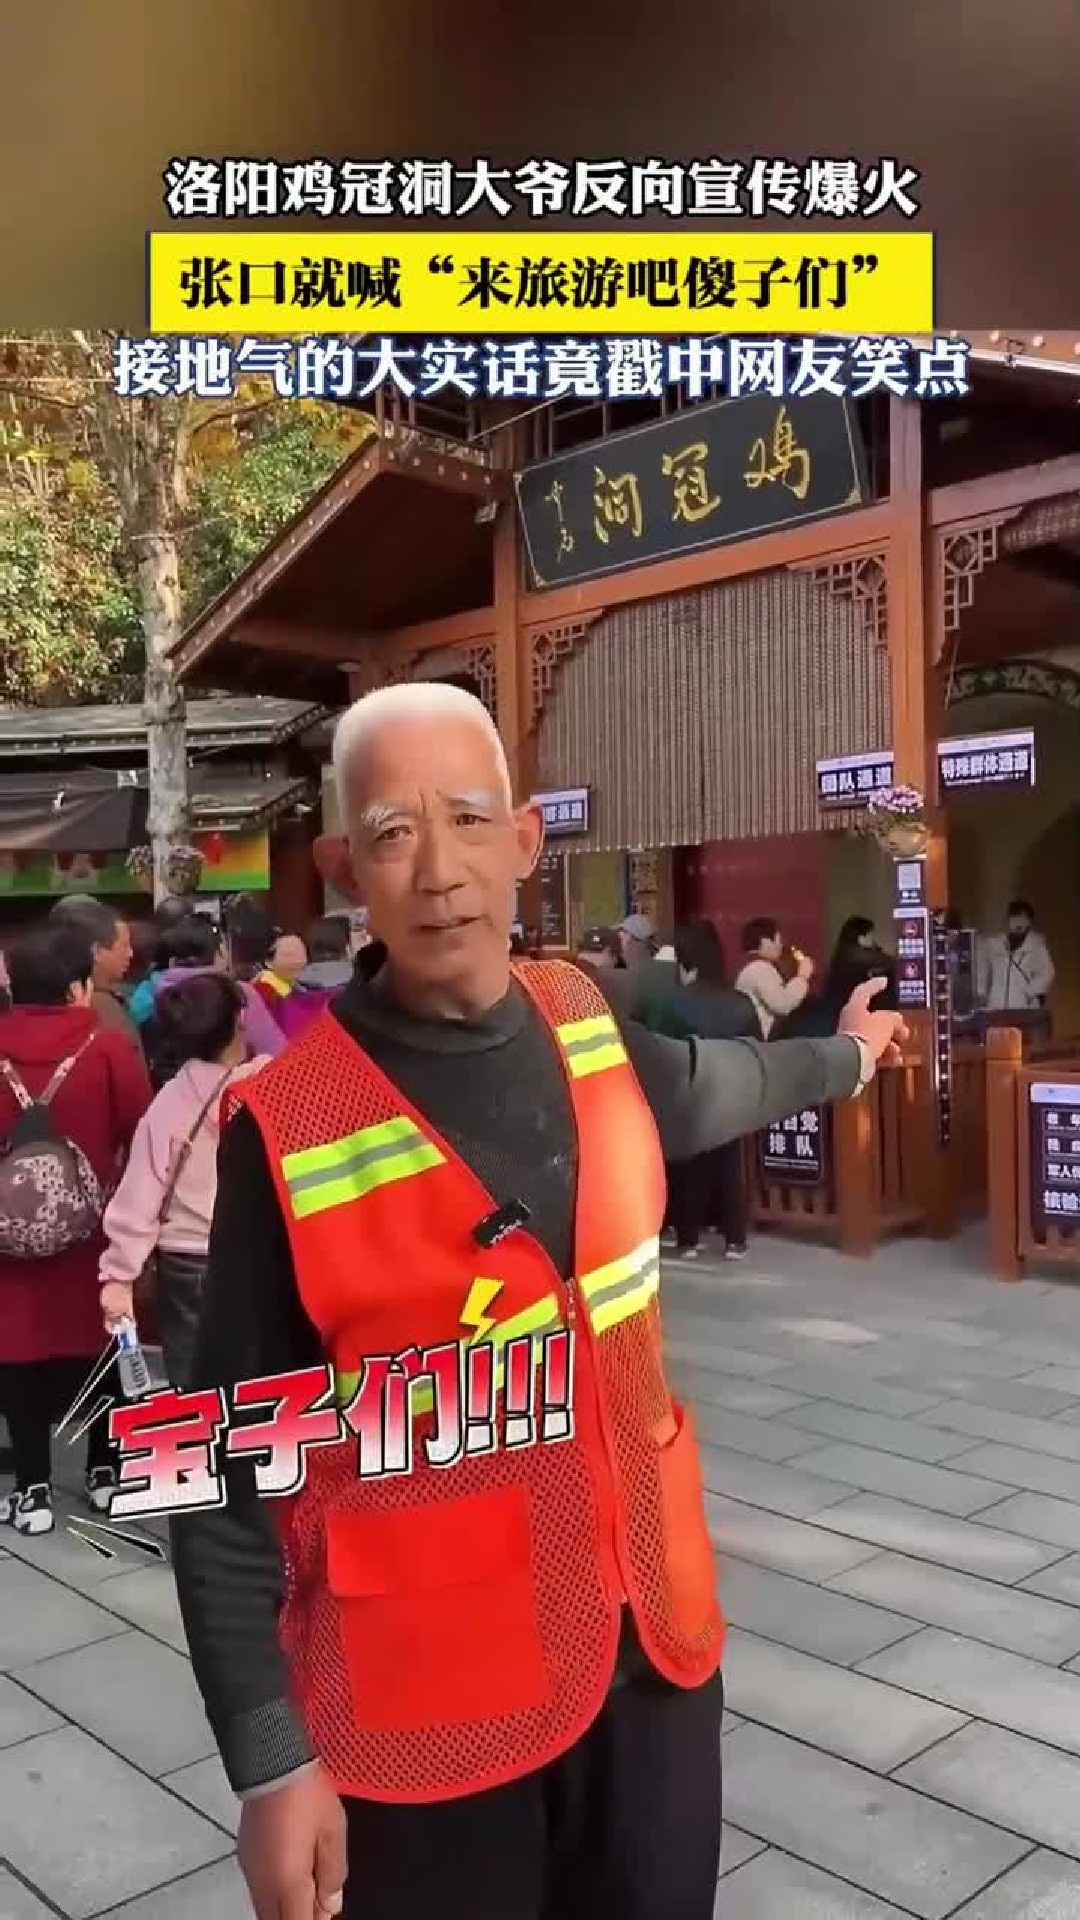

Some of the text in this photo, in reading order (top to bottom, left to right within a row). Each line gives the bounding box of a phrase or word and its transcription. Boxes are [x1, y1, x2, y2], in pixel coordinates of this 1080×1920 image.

[821, 766, 892, 794] 团队通道
[769, 1132, 814, 1156] 排队
